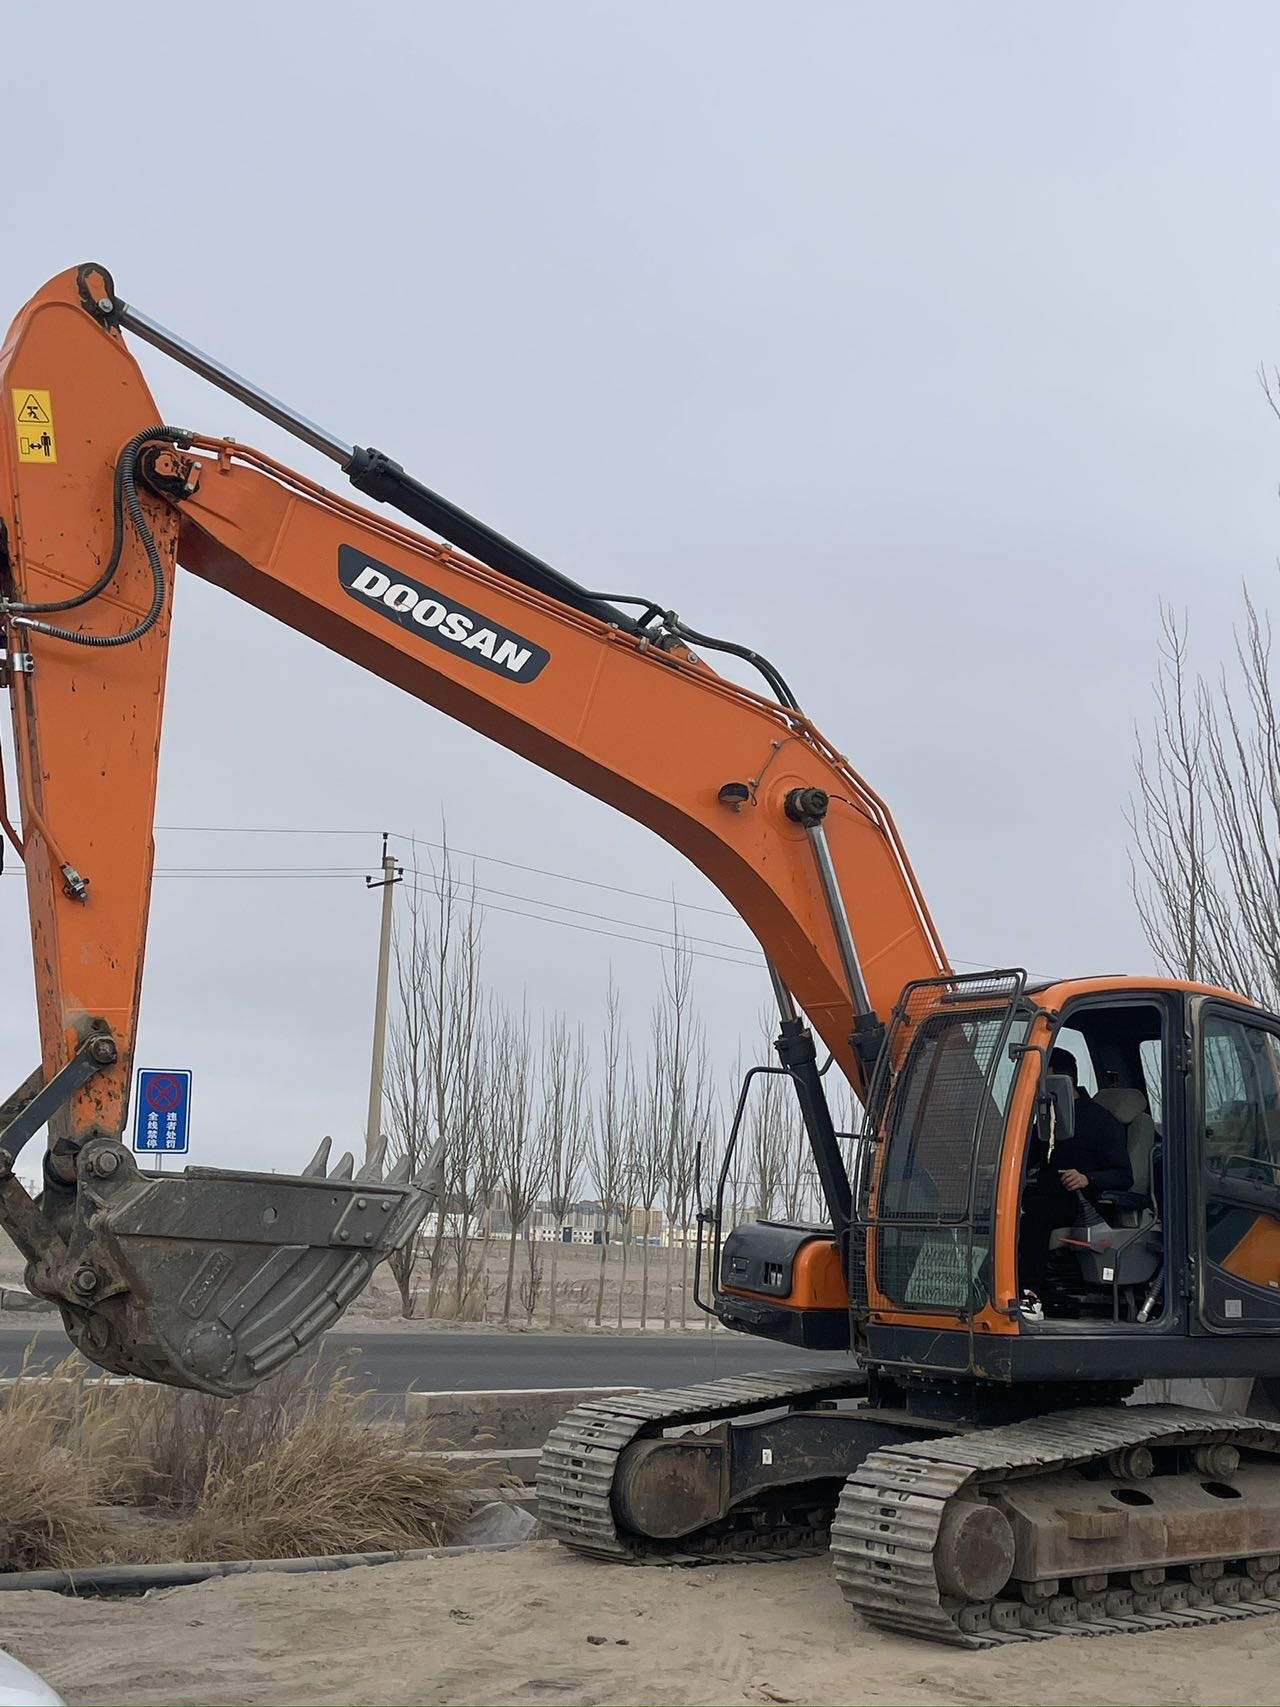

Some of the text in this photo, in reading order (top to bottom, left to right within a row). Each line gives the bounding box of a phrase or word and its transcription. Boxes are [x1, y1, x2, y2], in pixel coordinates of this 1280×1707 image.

[351, 566, 532, 672] DOOSAN
[146, 1111, 159, 1148] 全线禁停
[165, 1111, 177, 1149] 违者处罚
